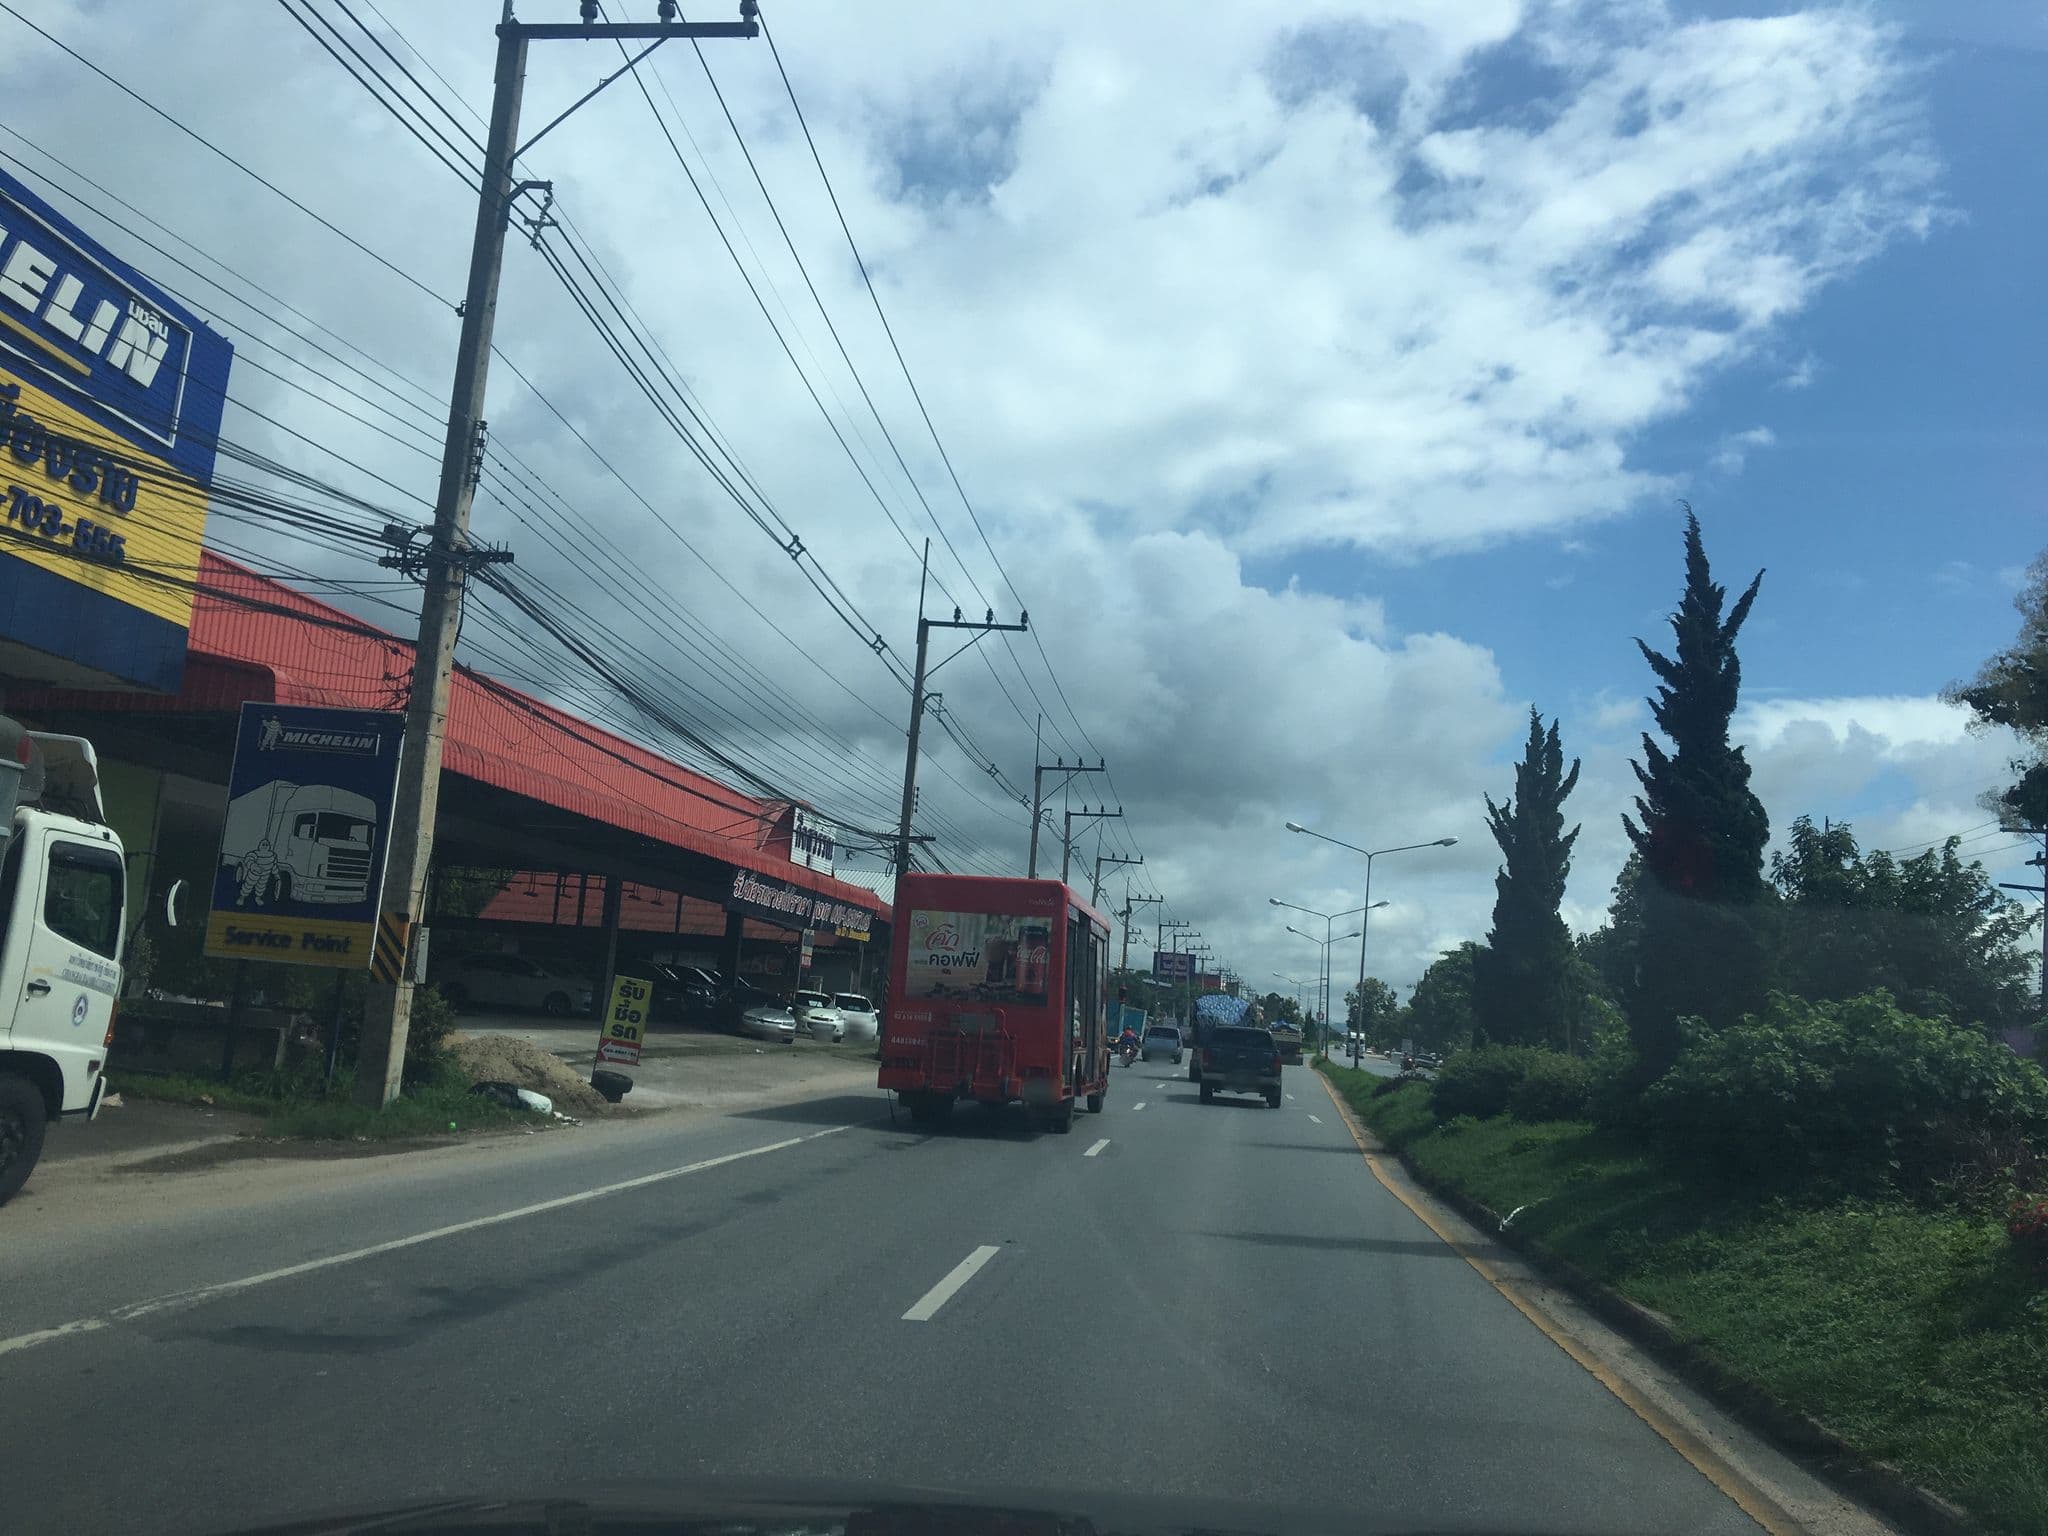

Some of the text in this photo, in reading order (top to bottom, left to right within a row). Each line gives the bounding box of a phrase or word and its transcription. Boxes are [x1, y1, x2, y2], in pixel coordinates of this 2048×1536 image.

[0, 225, 168, 388] ELIN
[283, 731, 374, 750] MICHELIN
[226, 926, 351, 954] Service Point
[929, 947, 980, 968] คอฟฟี่
[618, 980, 645, 1000] รับ
[614, 999, 641, 1024] ซื้อ
